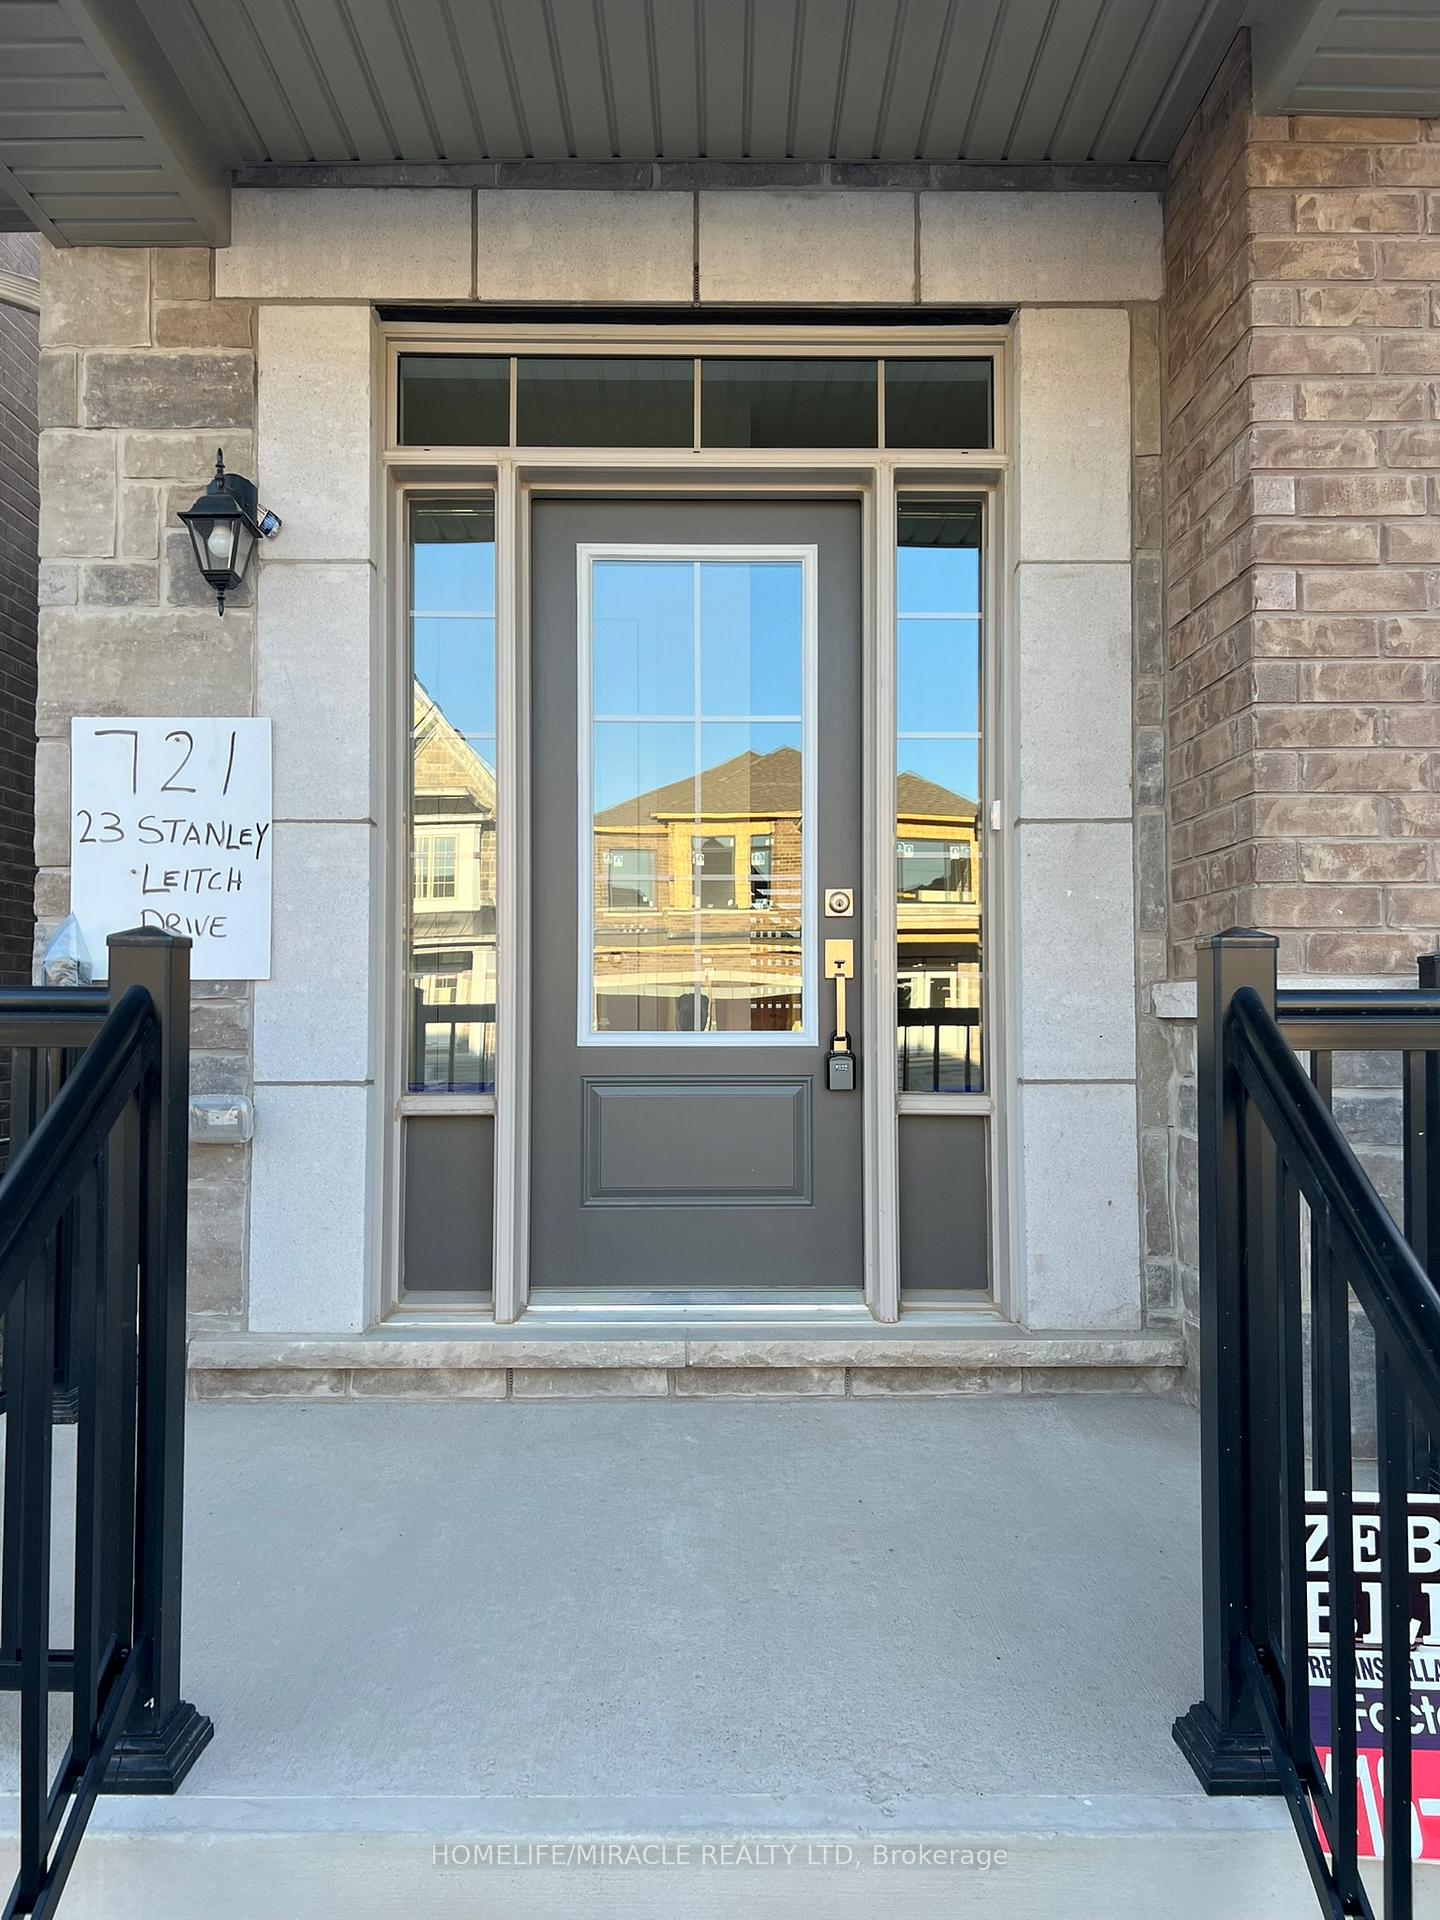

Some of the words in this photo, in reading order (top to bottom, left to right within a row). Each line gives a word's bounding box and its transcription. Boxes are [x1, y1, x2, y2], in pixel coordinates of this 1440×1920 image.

[94, 730, 236, 796] 721
[77, 809, 125, 844] 23
[138, 815, 270, 860] STANLEY
[142, 863, 242, 894] LEITCH
[141, 908, 227, 938] DRIVE
